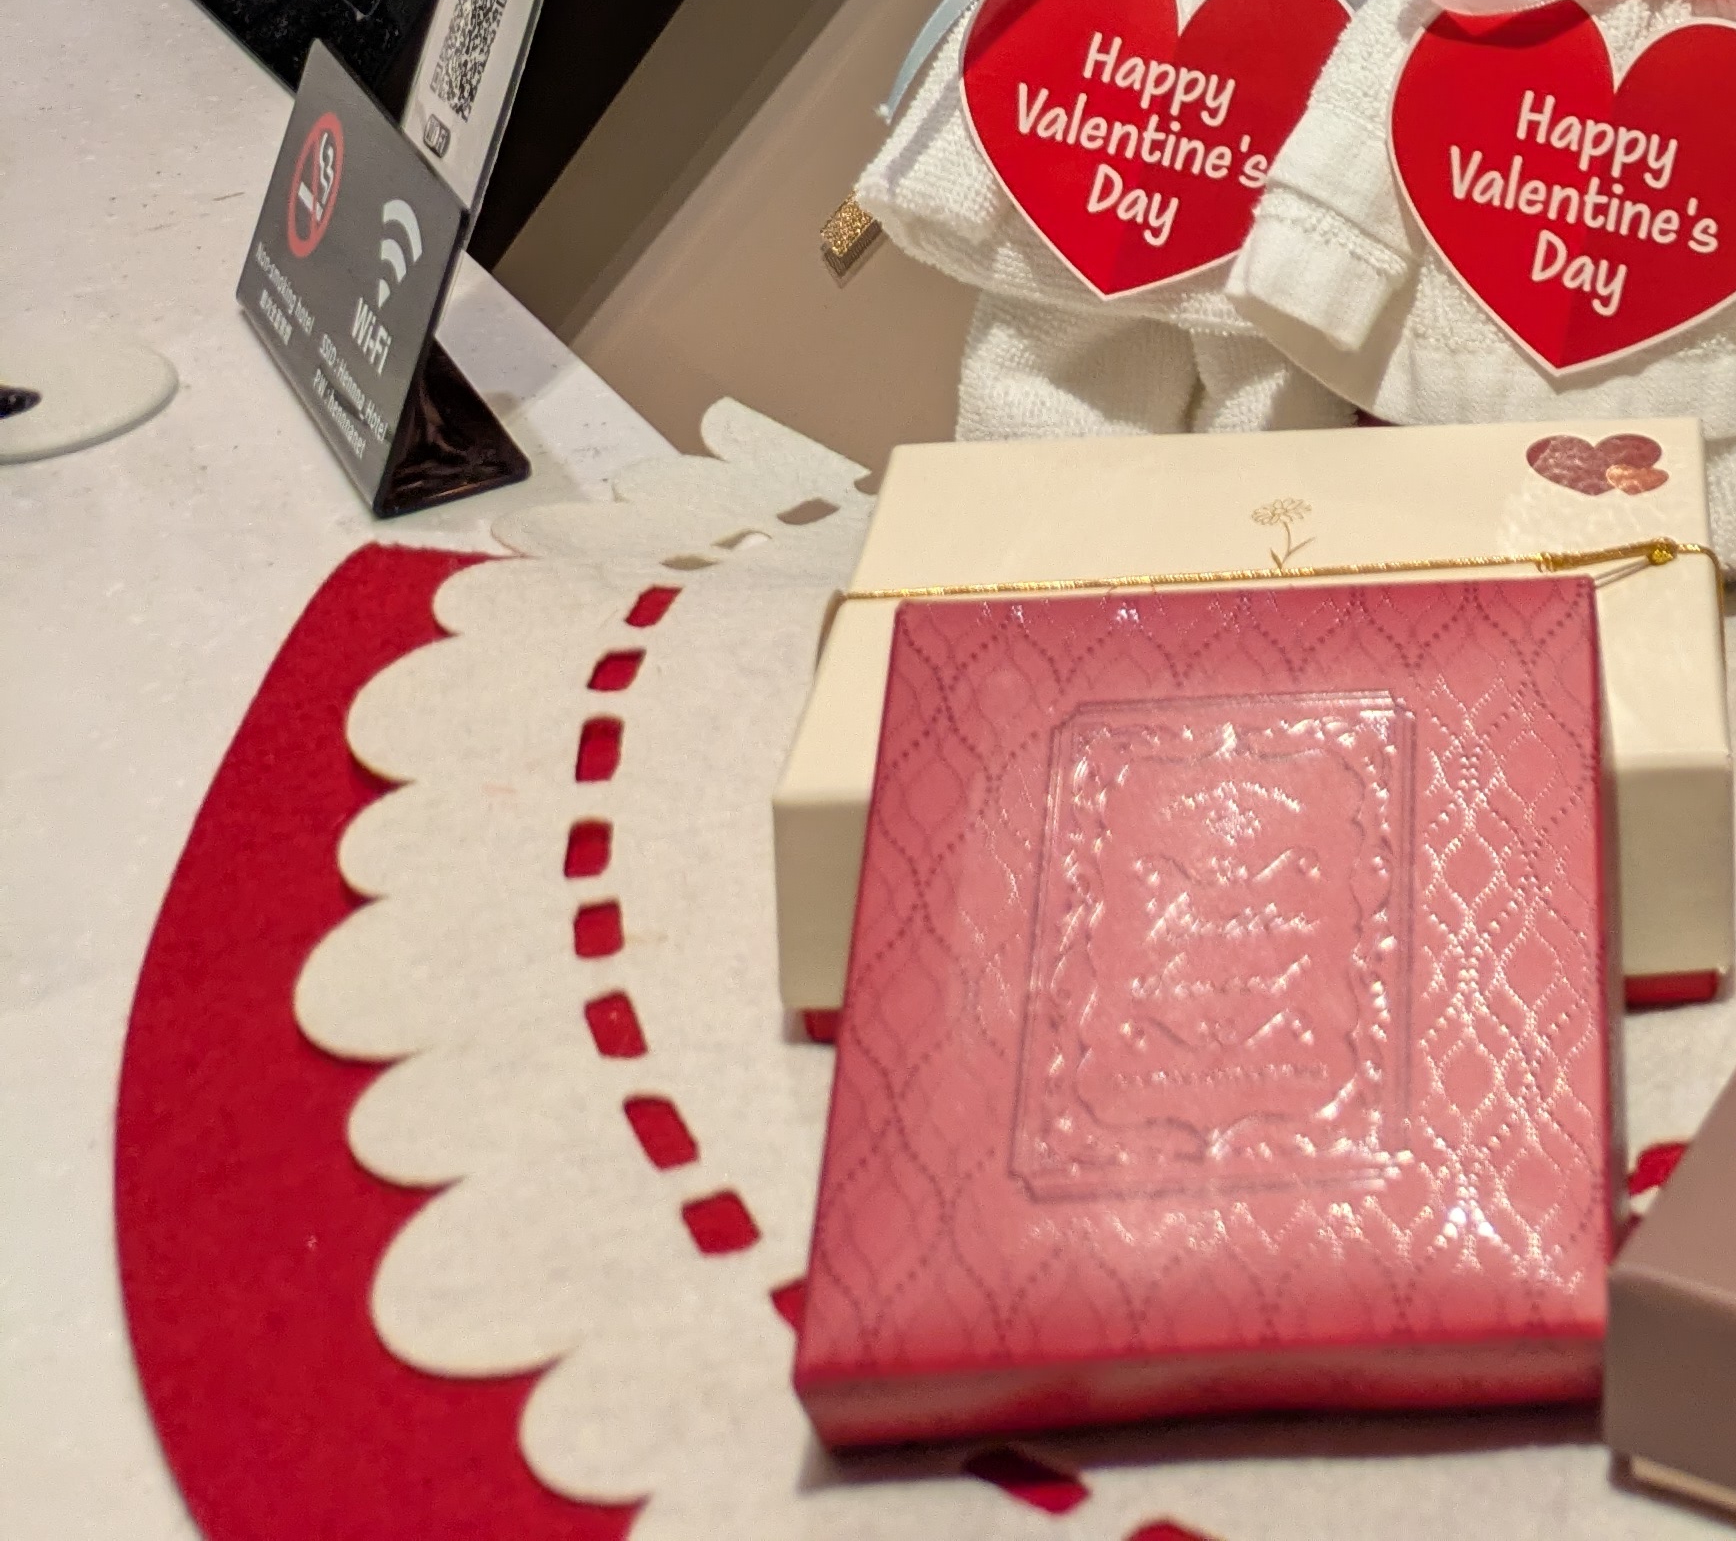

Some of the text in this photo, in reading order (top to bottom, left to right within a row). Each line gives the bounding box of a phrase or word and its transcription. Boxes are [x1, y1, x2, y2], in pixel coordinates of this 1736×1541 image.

[1081, 30, 1237, 130] Happy
[1016, 81, 1269, 191] Valentine's
[1516, 89, 1679, 192] Happy
[1085, 163, 1181, 248] Day
[1448, 144, 1720, 255] Valentine's
[294, 297, 315, 336] hotel
[1530, 229, 1628, 318] Day
[352, 297, 392, 376] Wi-Fi
